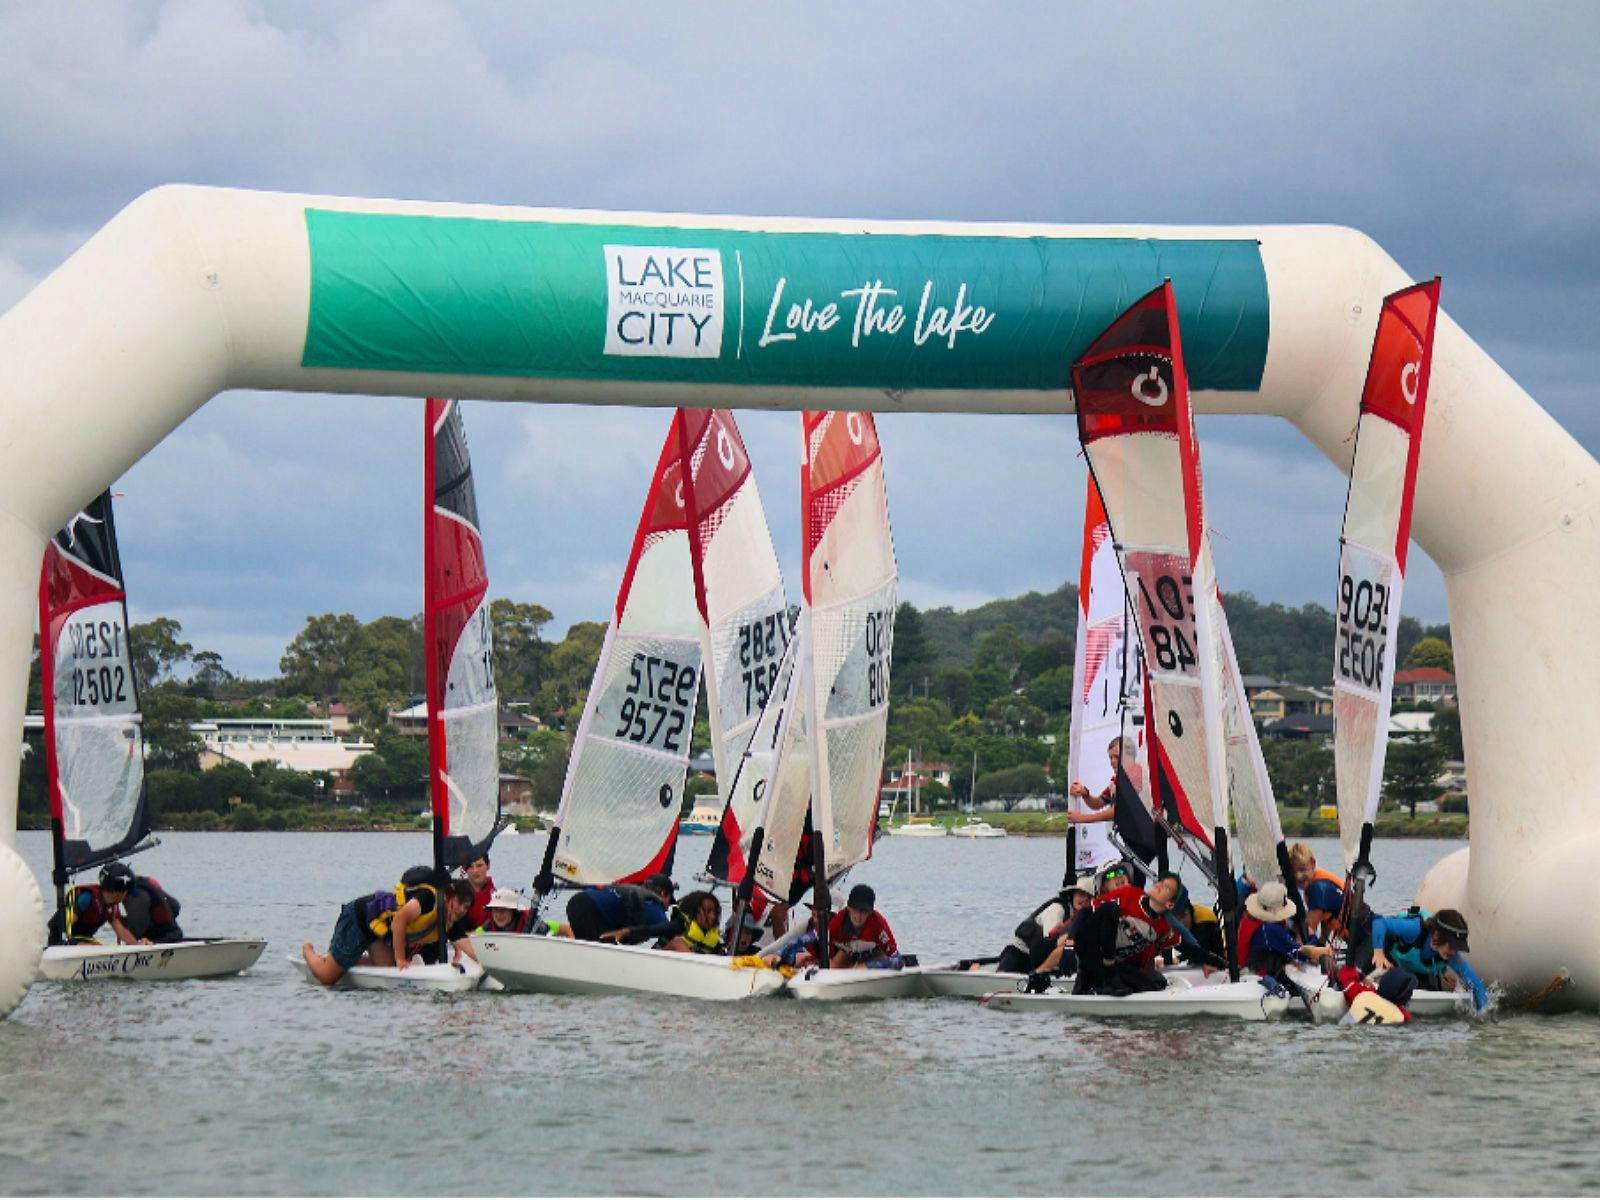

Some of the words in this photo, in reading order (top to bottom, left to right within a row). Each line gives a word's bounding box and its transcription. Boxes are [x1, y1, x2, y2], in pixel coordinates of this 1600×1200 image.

[617, 254, 713, 289] LAKE
[619, 290, 714, 309] MACQUARIE
[758, 276, 841, 348] Love
[616, 311, 712, 347] CITY
[72, 665, 127, 706] 12502
[615, 697, 686, 751] 9572
